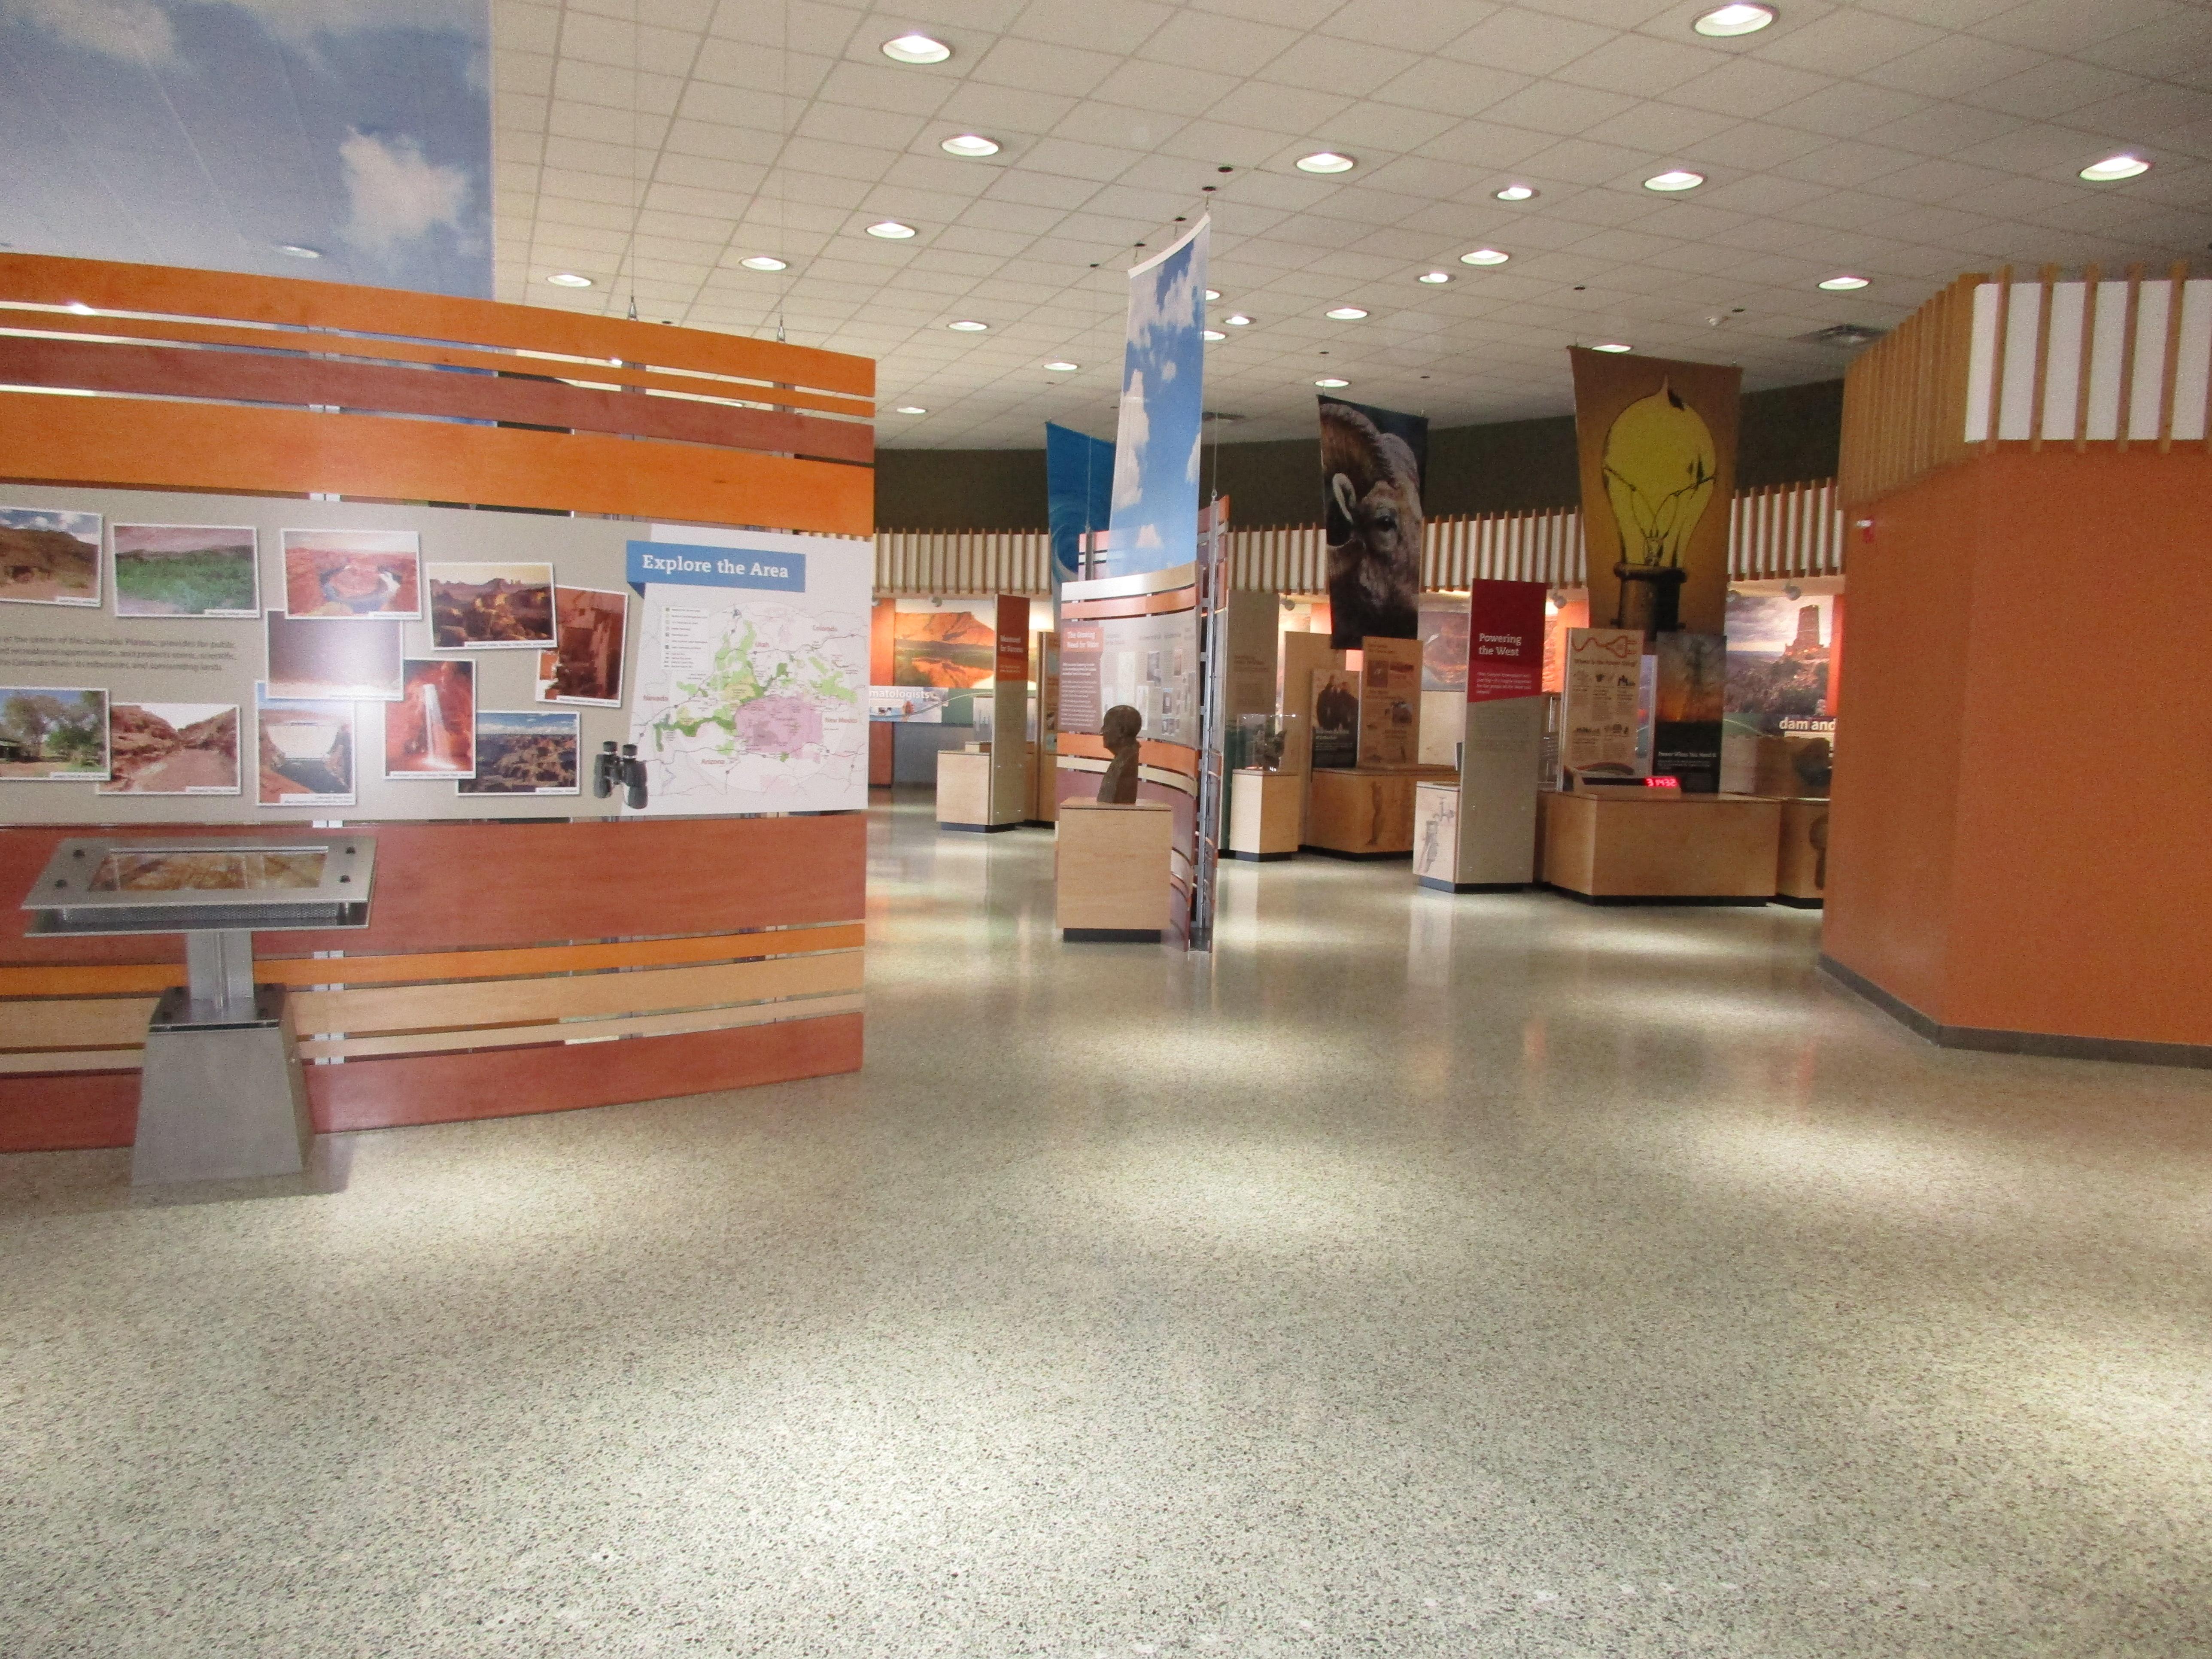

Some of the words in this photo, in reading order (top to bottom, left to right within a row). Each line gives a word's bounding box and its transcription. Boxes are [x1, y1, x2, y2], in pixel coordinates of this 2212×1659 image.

[642, 554, 712, 574] Explore
[717, 559, 745, 575] the
[750, 562, 789, 578] Area
[1479, 633, 1522, 646] Powering
[1479, 645, 1494, 655] the
[1495, 647, 1519, 656] West
[1779, 717, 1808, 730] dam
[1811, 717, 1837, 731] and
